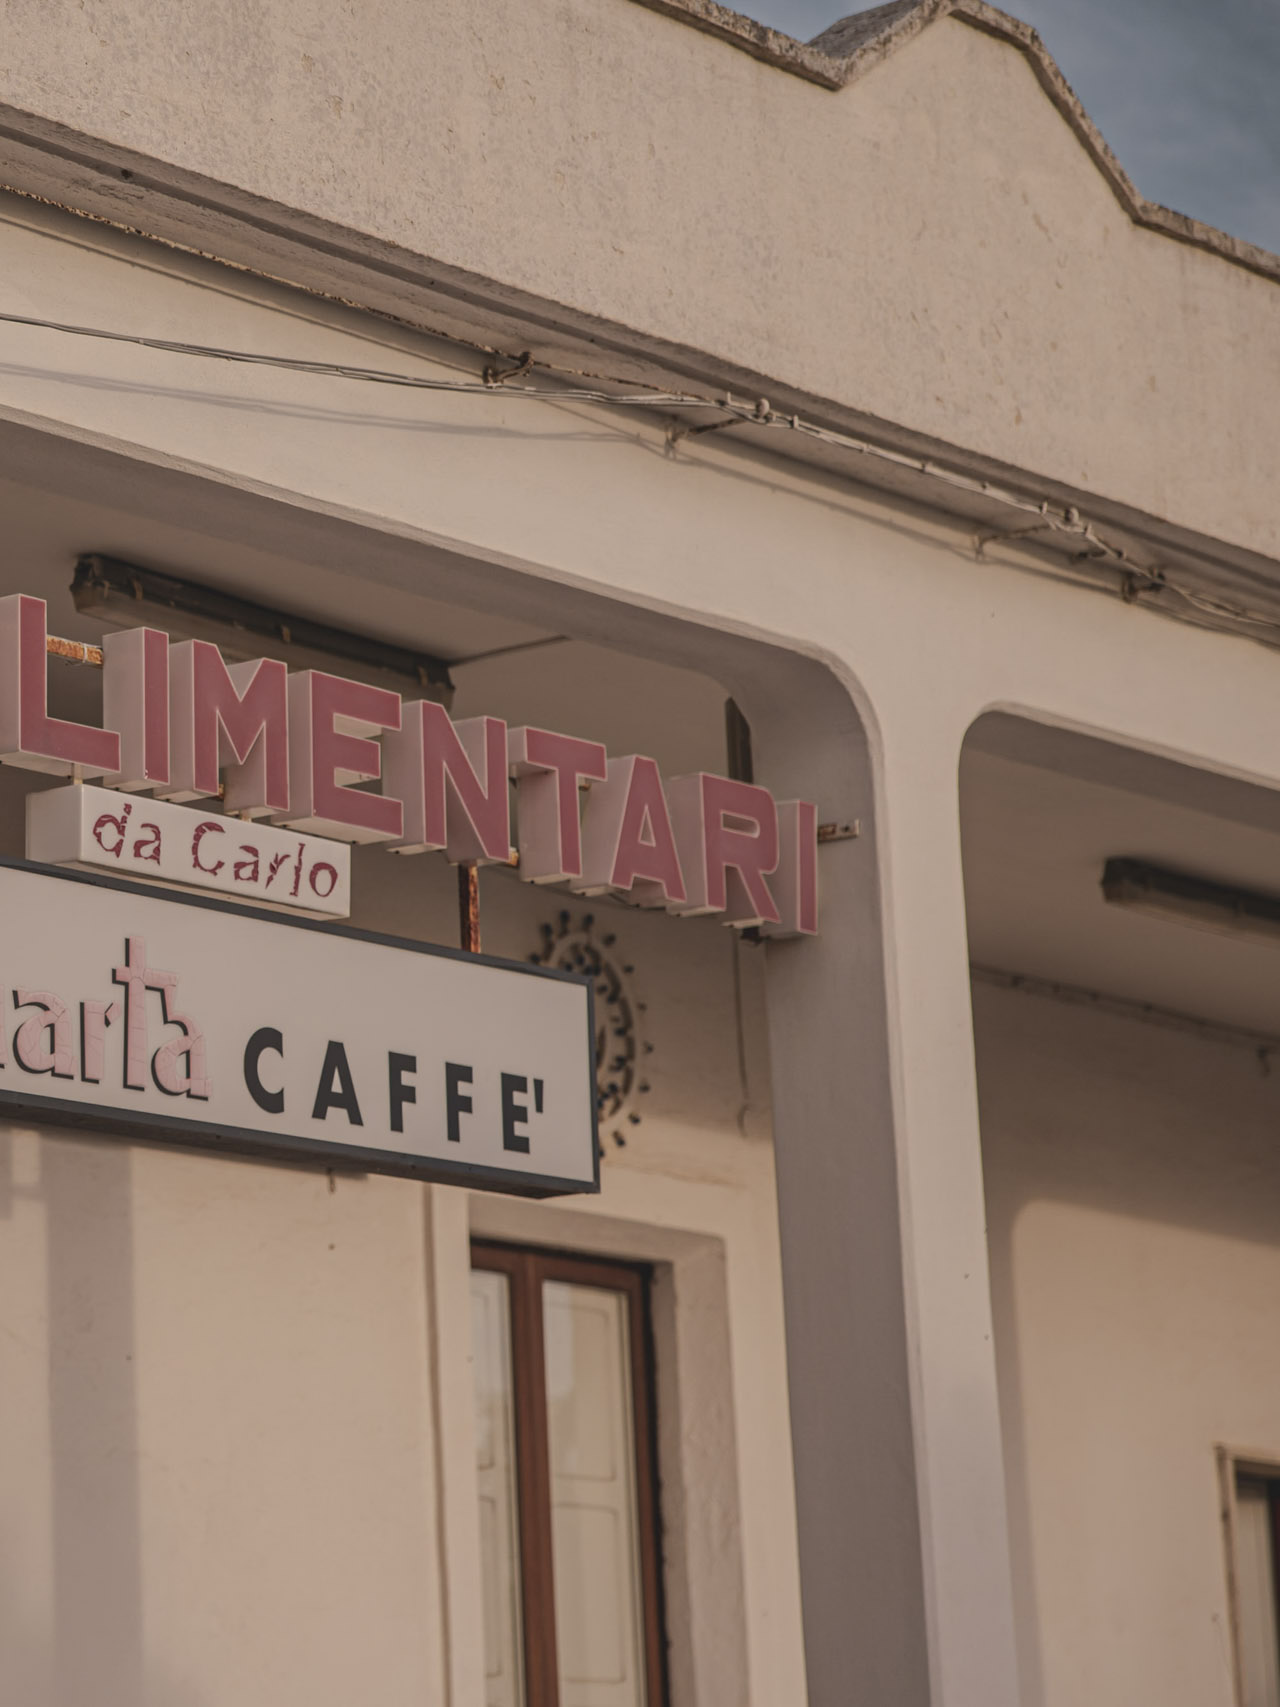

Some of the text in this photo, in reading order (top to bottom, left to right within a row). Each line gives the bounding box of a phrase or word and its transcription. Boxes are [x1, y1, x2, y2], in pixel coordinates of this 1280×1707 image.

[92, 803, 339, 900] da Carlo
[243, 1026, 545, 1155] CAFFE'
